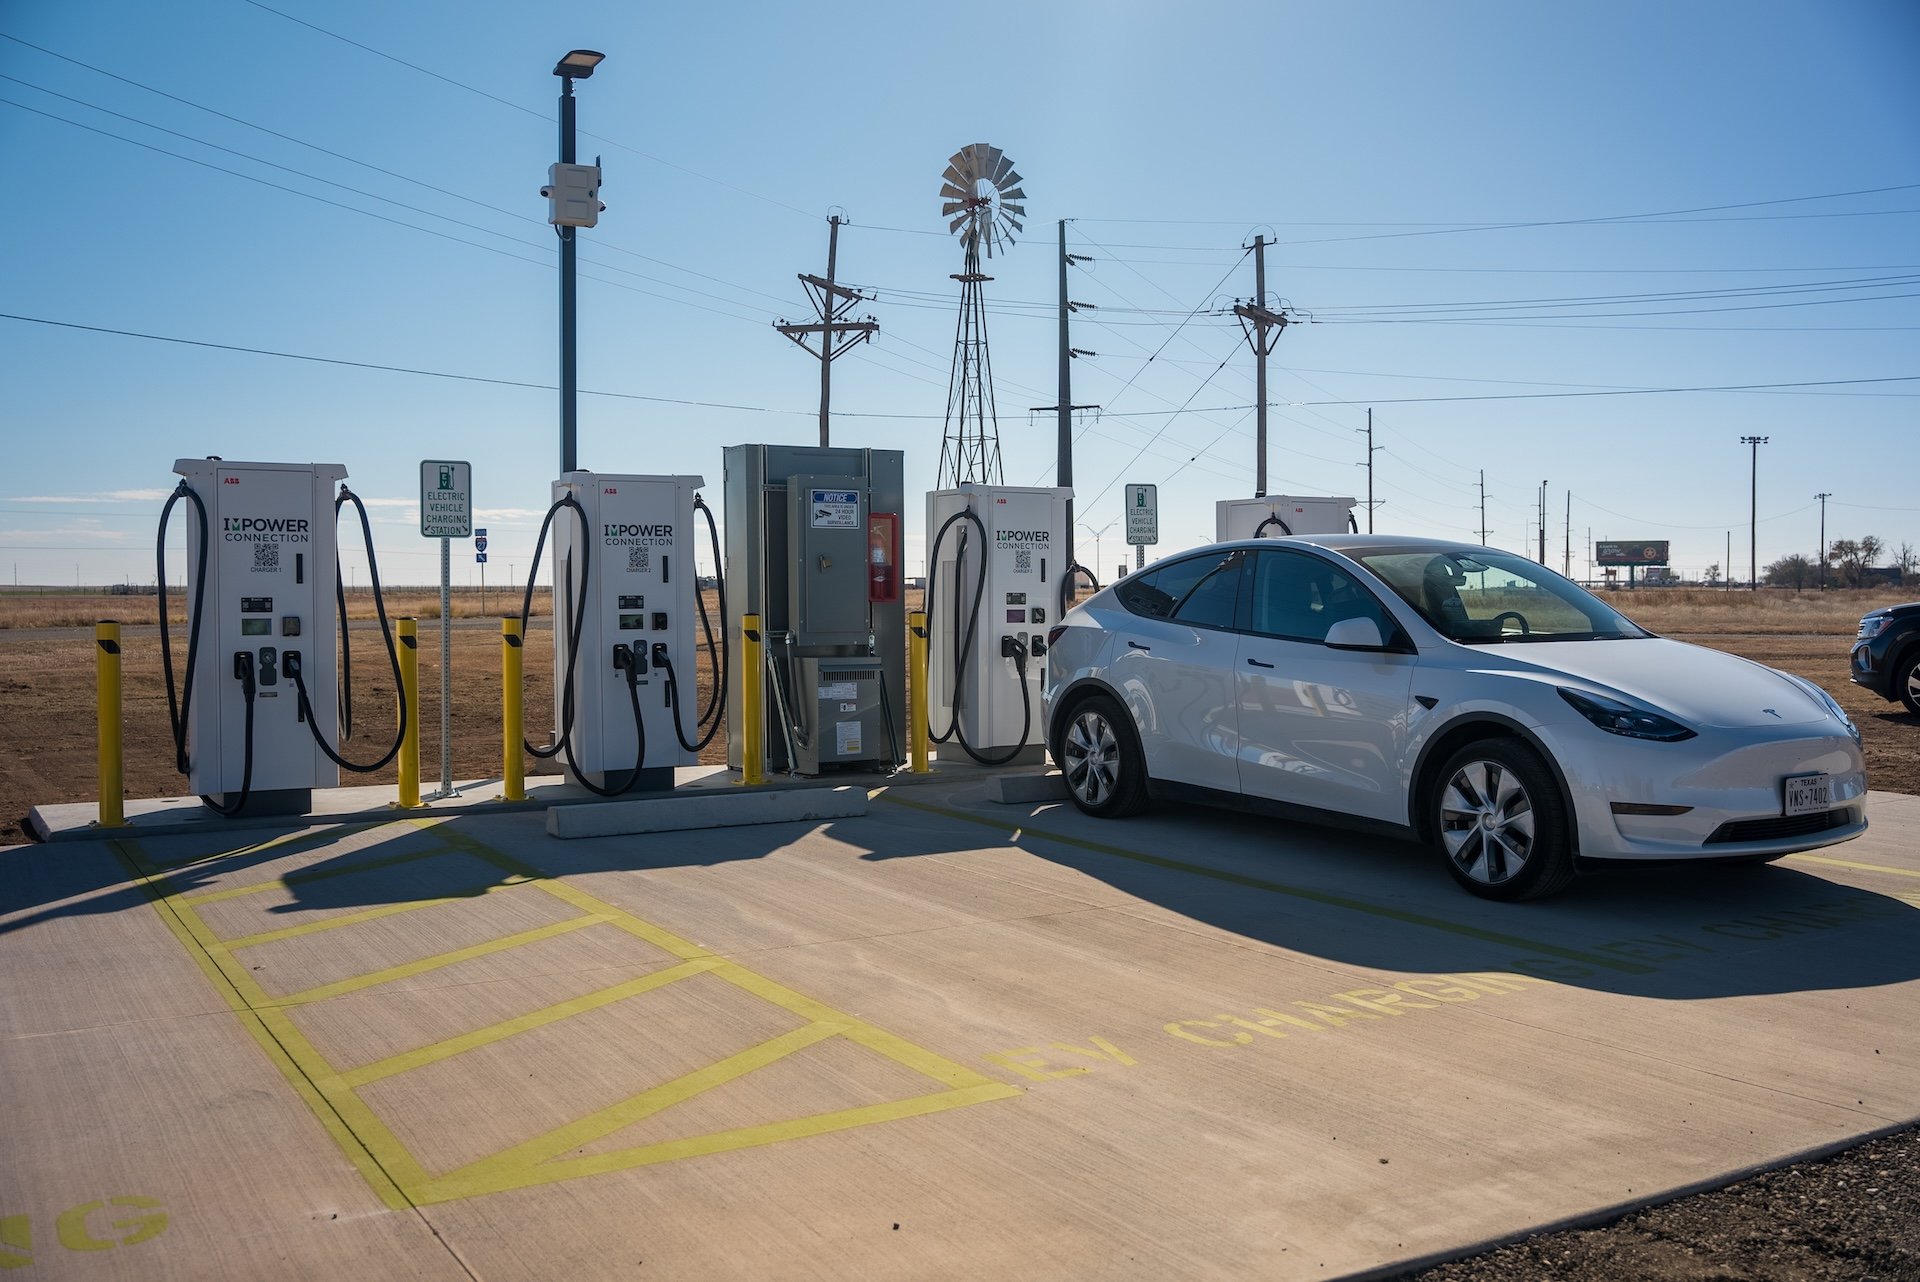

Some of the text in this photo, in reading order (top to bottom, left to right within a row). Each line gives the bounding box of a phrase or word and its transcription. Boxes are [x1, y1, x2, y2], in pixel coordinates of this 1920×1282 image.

[428, 492, 465, 501] ELECTRIC
[823, 493, 847, 502] NOTICE
[430, 504, 463, 512] VEHICLE
[426, 515, 467, 523] CHARGING
[431, 526, 461, 535] STATION
[225, 533, 309, 543] CONNECTION
[605, 538, 673, 546] CONNECTION
[996, 542, 1050, 550] CONNECTION
[1801, 778, 1817, 787] TEXAS
[982, 1035, 1139, 1082] EV
